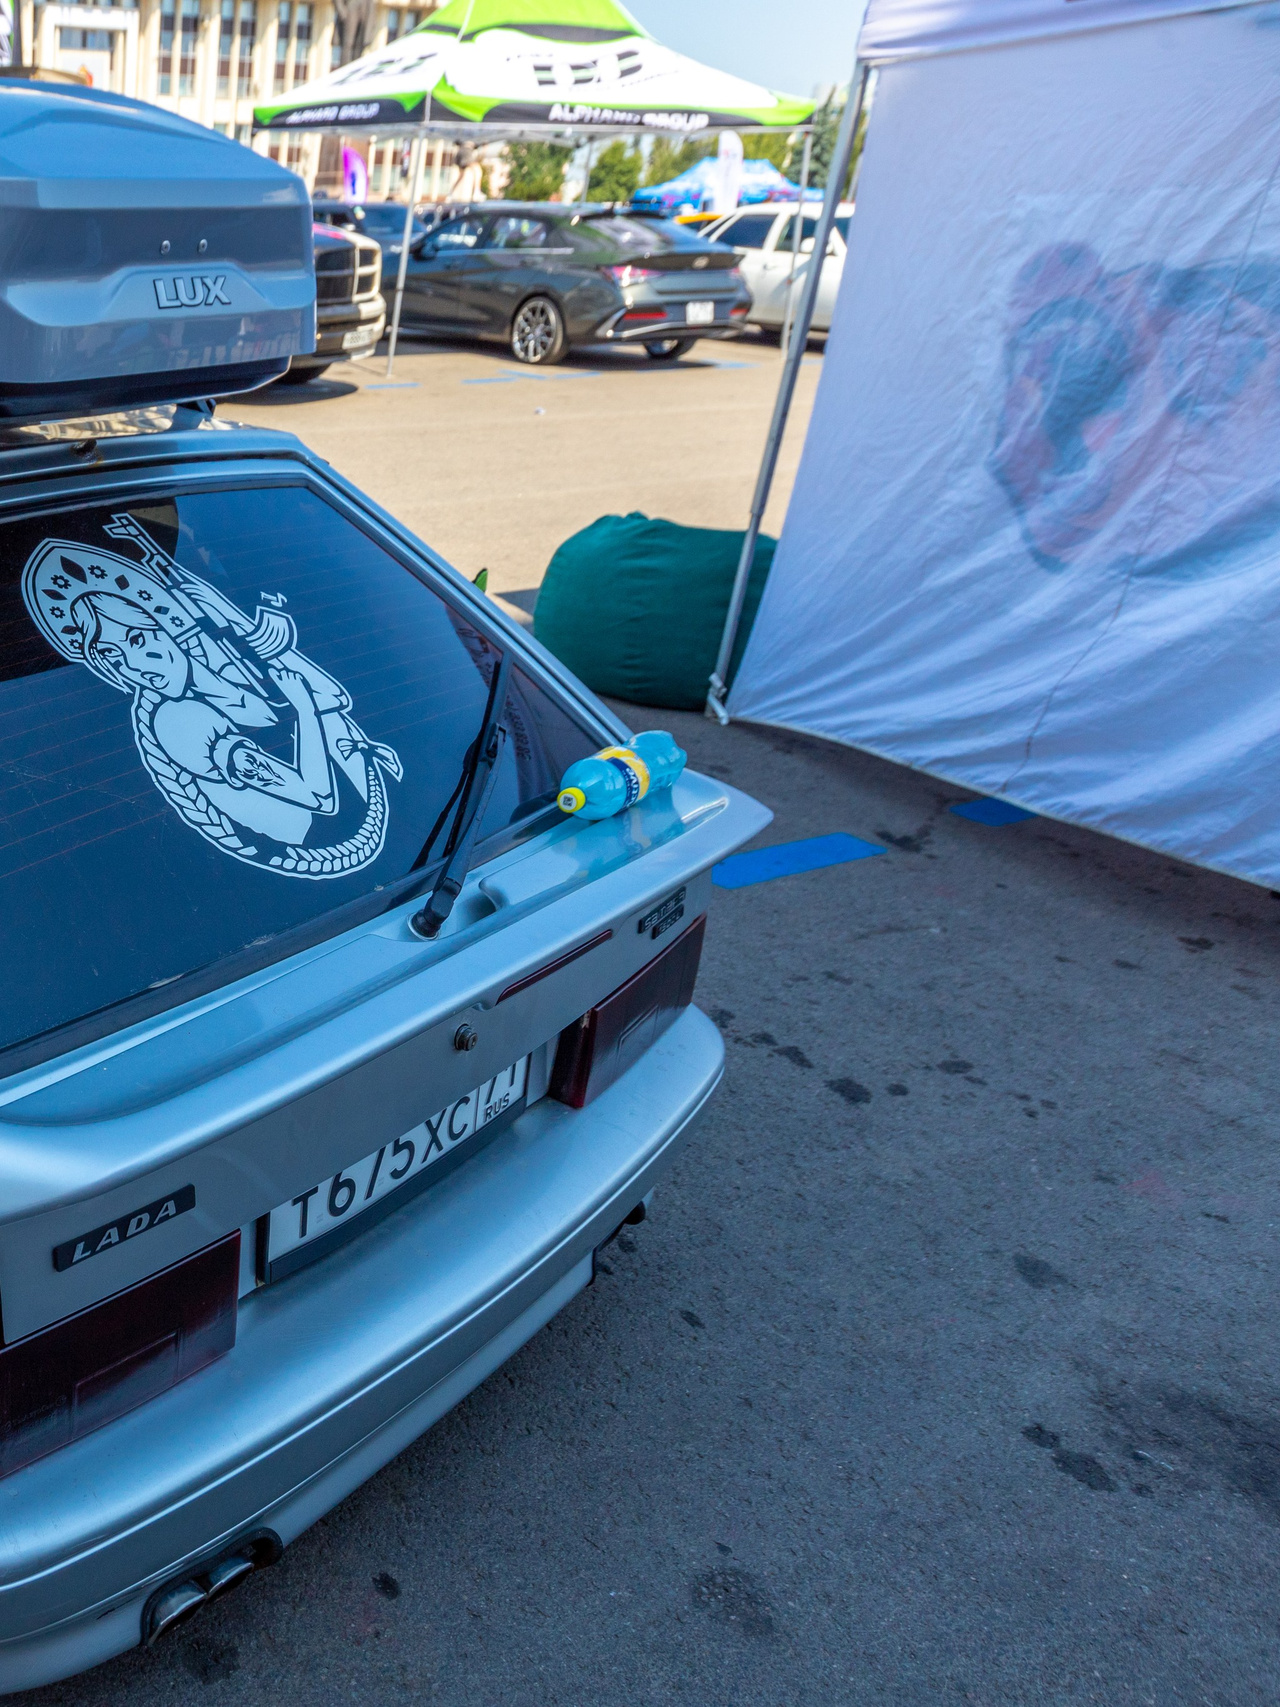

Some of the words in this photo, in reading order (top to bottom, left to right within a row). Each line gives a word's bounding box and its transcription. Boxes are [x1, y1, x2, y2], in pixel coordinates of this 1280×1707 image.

[642, 113, 709, 131] GROUP
[153, 275, 231, 310] LUX
[483, 1092, 511, 1123] RUS
[72, 1200, 177, 1263] LADA
